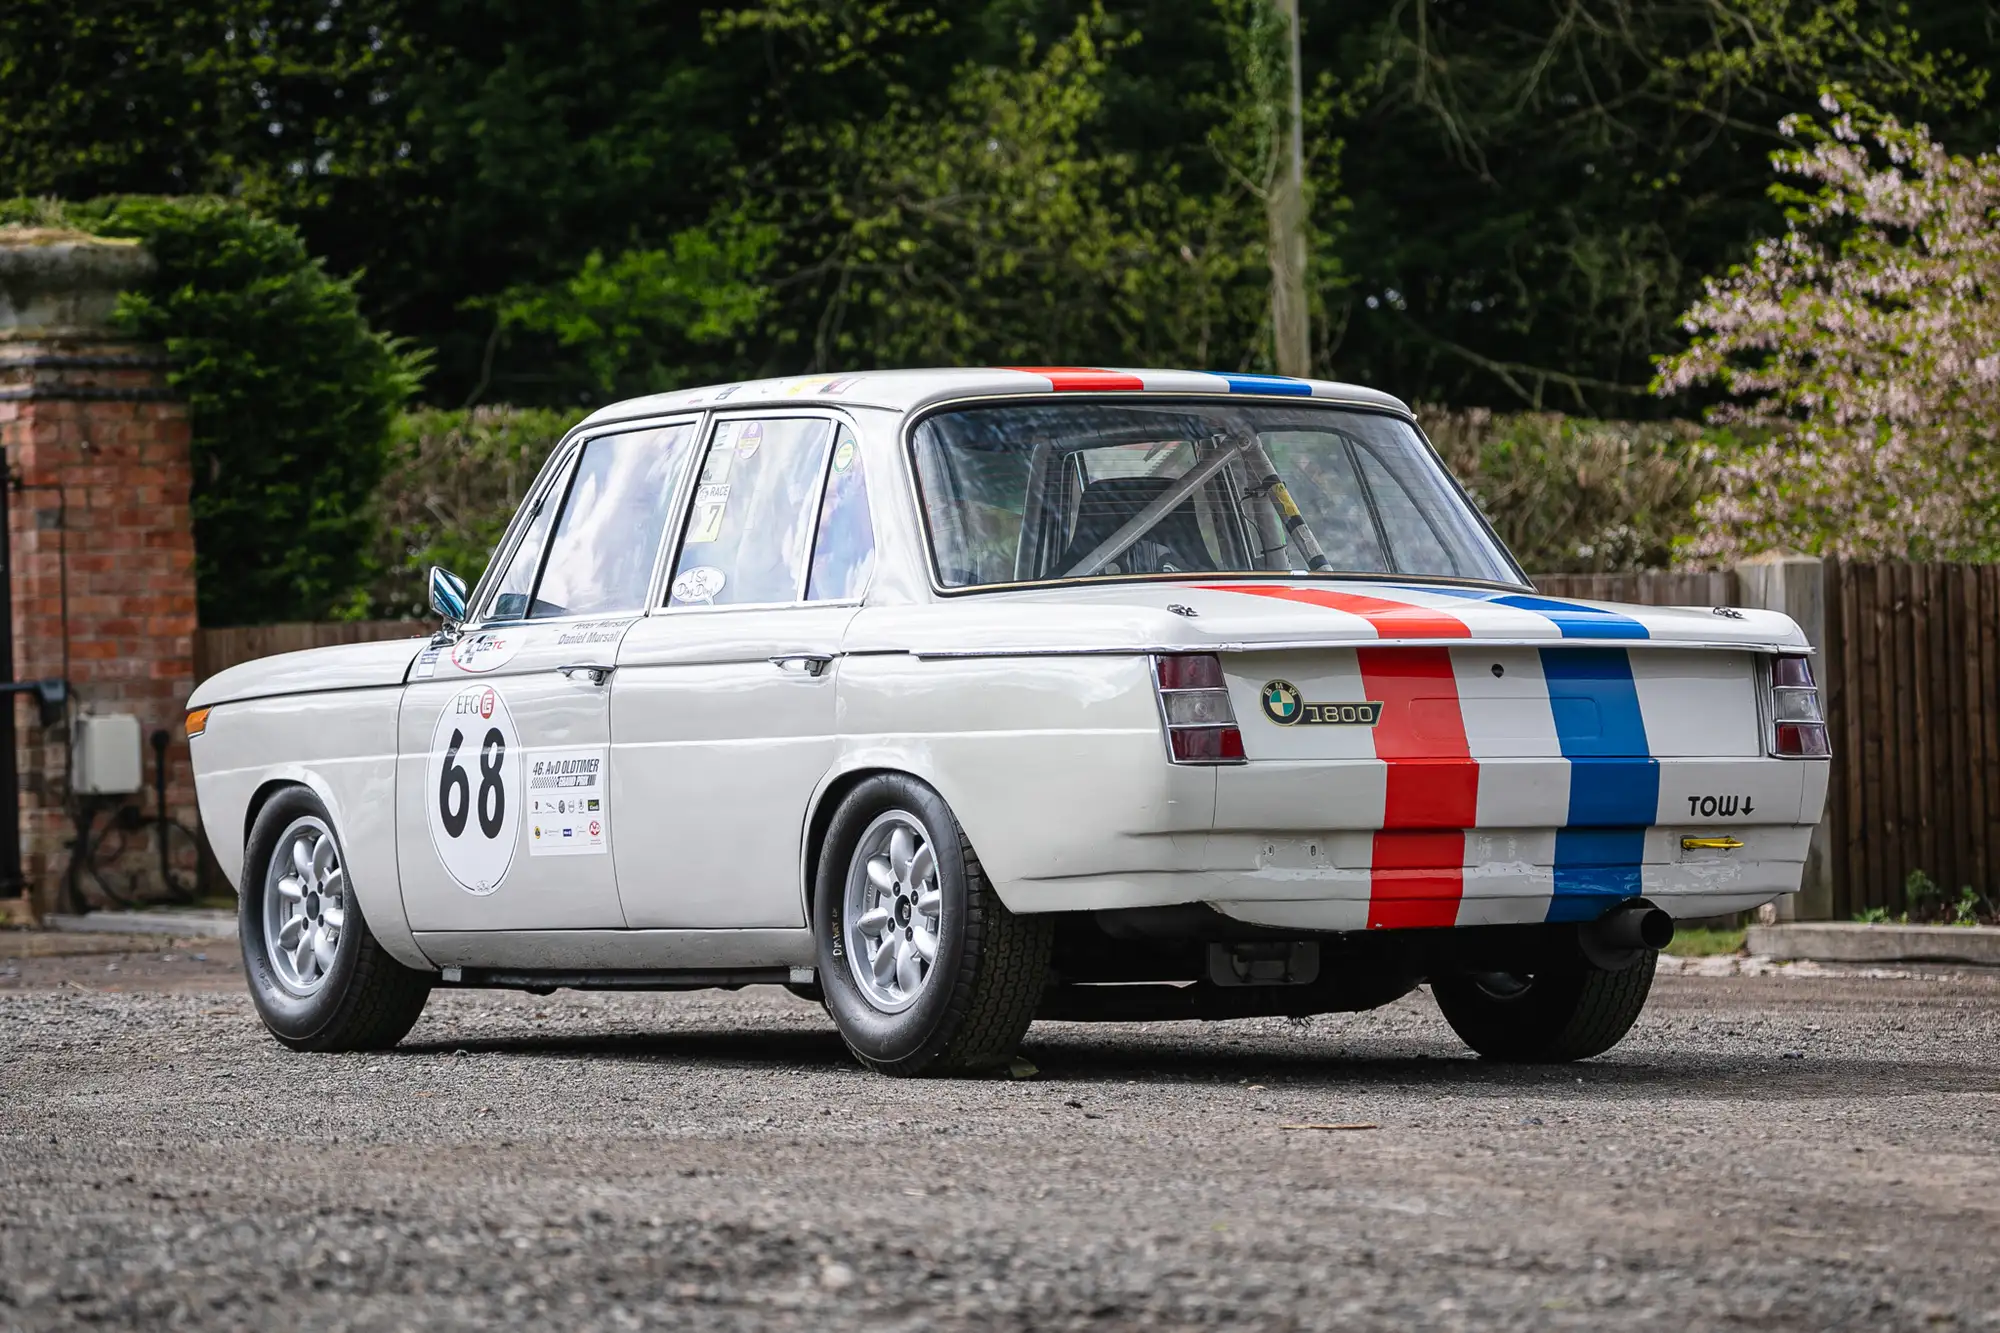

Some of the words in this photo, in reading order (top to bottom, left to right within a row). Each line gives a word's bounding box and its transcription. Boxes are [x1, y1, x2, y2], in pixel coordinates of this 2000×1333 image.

[709, 486, 729, 496] RACE
[706, 505, 721, 533] 7
[557, 632, 586, 645] Daniel
[586, 631, 621, 643] Mursall
[456, 695, 479, 714] EFG
[1264, 682, 1297, 697] BMW
[1305, 706, 1373, 722] 1800
[545, 761, 561, 775] AvD
[561, 759, 600, 774] OLDTIMER
[440, 727, 505, 839] 68
[1688, 795, 1738, 817] TOW
